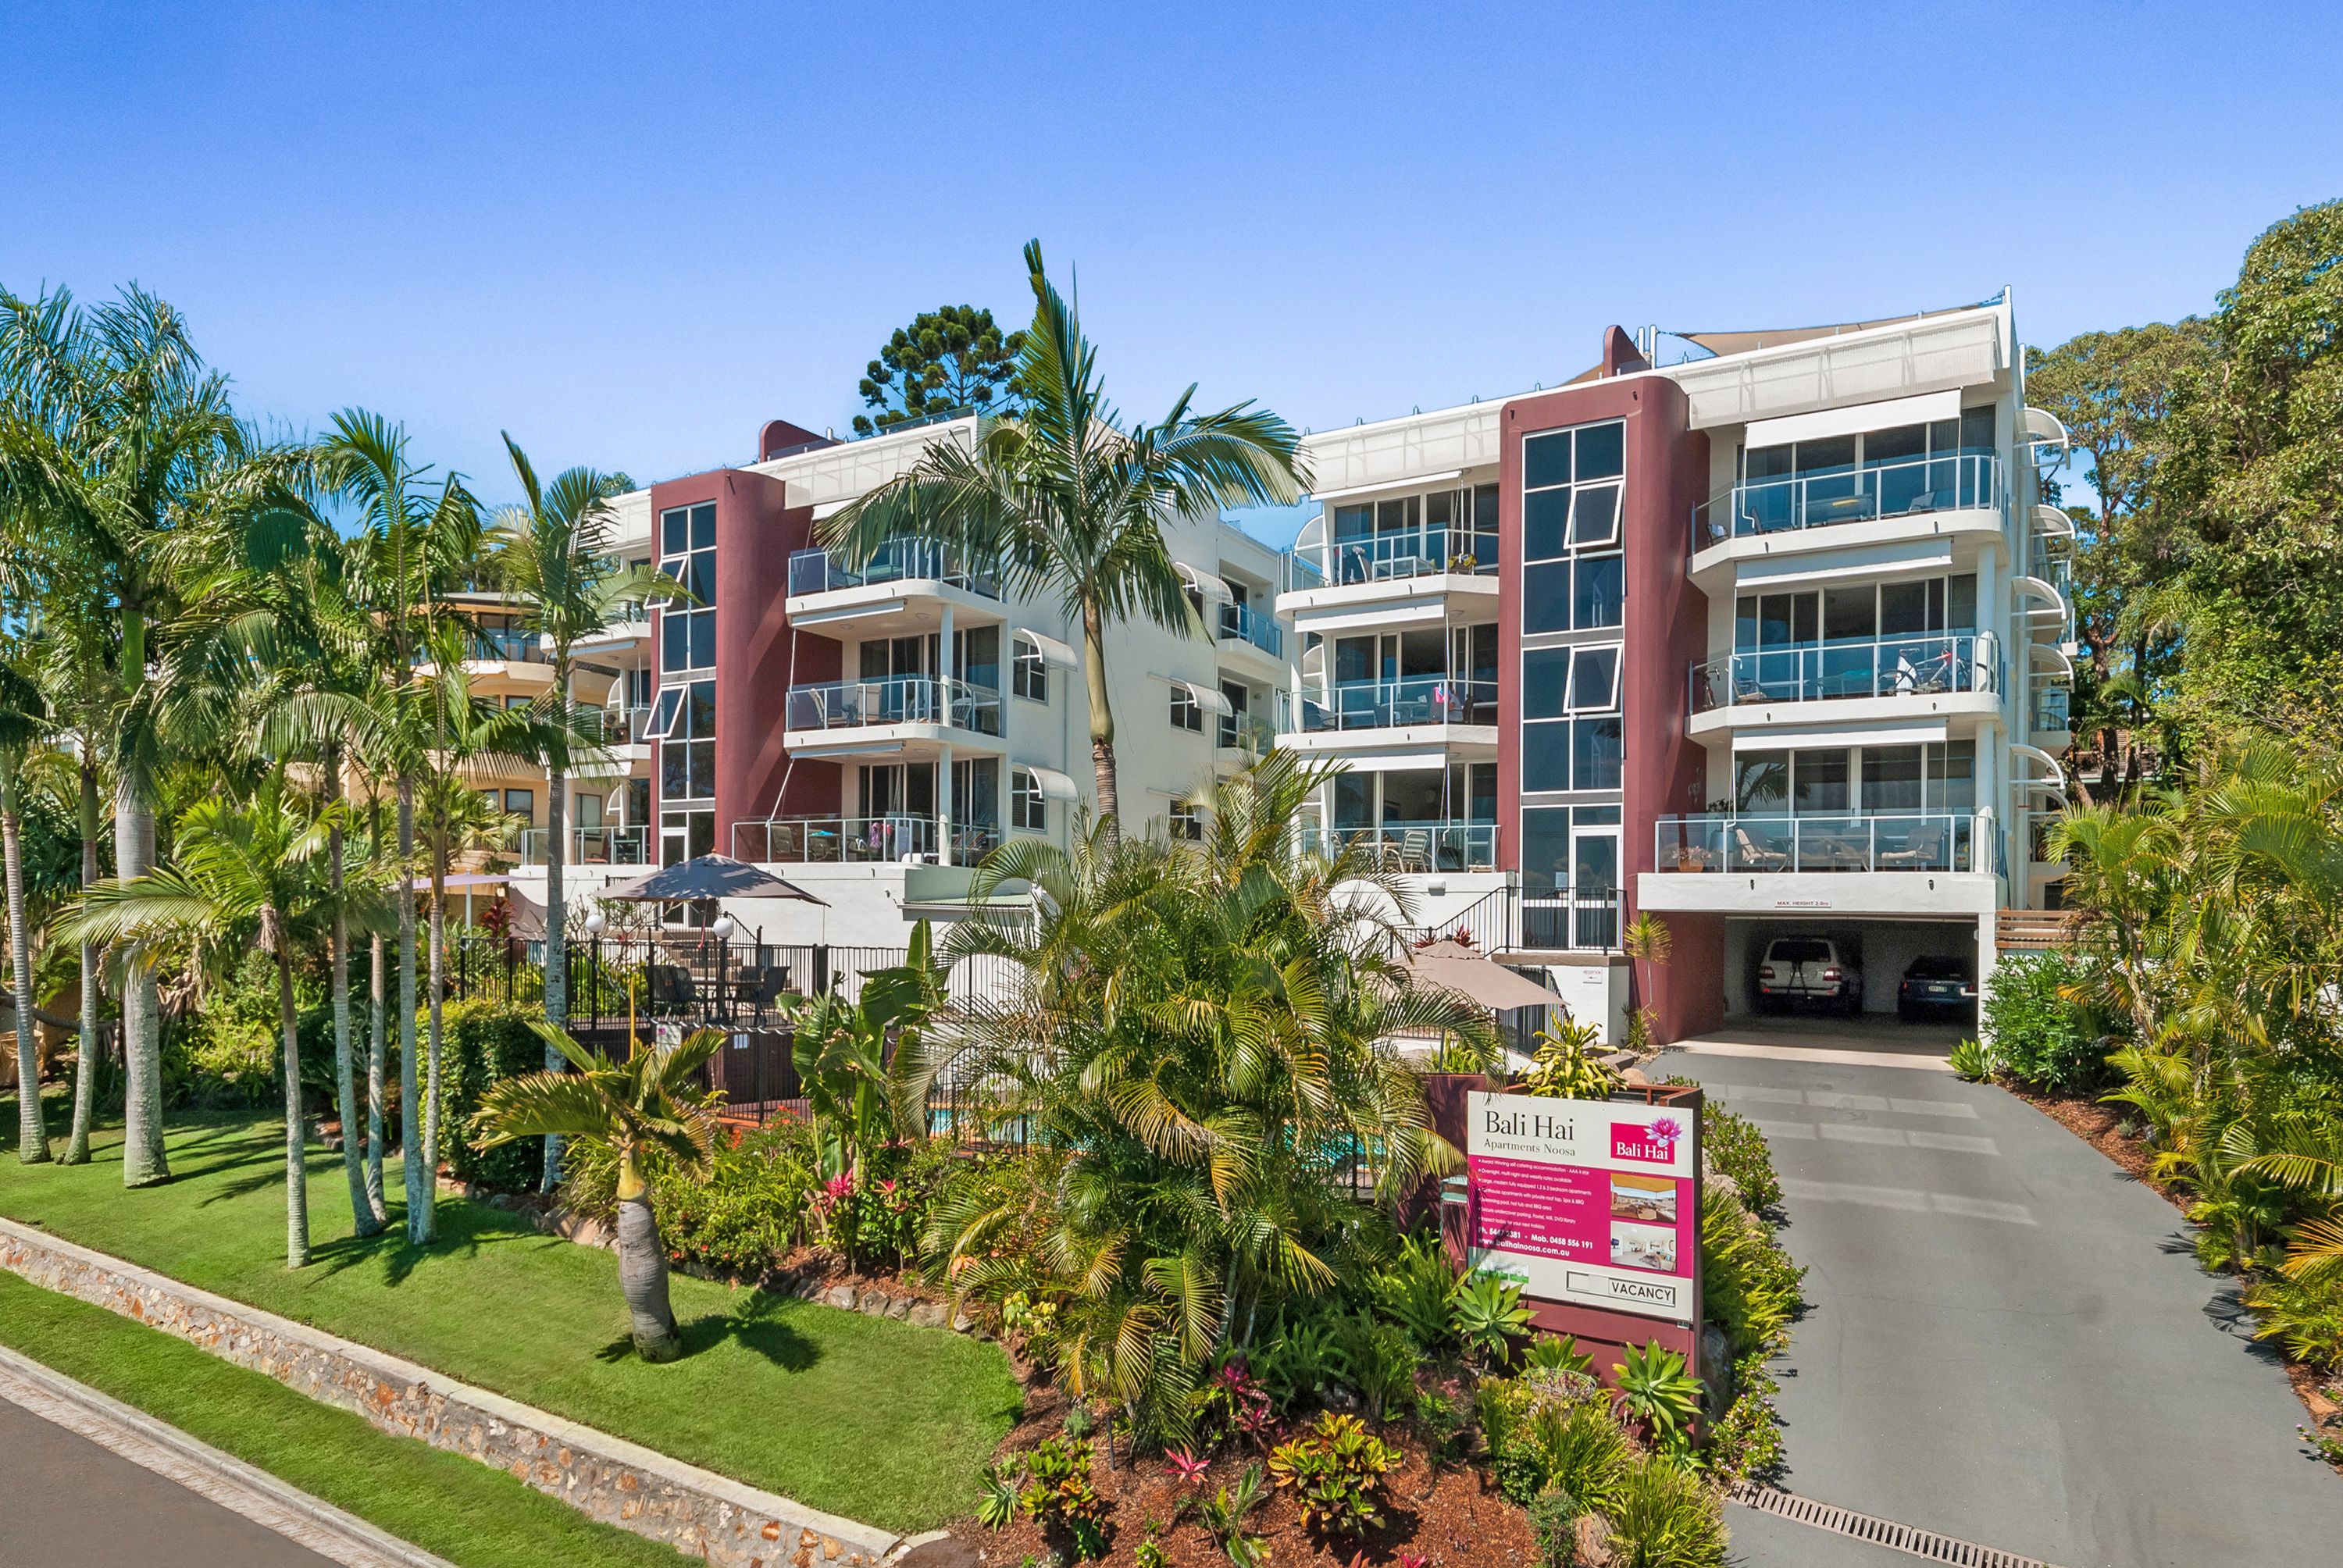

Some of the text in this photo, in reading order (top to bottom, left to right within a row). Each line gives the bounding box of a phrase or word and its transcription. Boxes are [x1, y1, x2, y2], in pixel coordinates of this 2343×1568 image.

[1484, 1110, 1574, 1141] Bali Hai
[1484, 1138, 1576, 1156] Apartments Noosa
[1615, 1142, 1668, 1160] Bali Hai
[1506, 1230, 1521, 1238] 2381
[1531, 1234, 1549, 1244] Mob.
[1550, 1236, 1567, 1246] 0458
[1567, 1238, 1580, 1248] 556
[1582, 1240, 1593, 1249] 191
[1612, 1281, 1671, 1301] VACANCY
